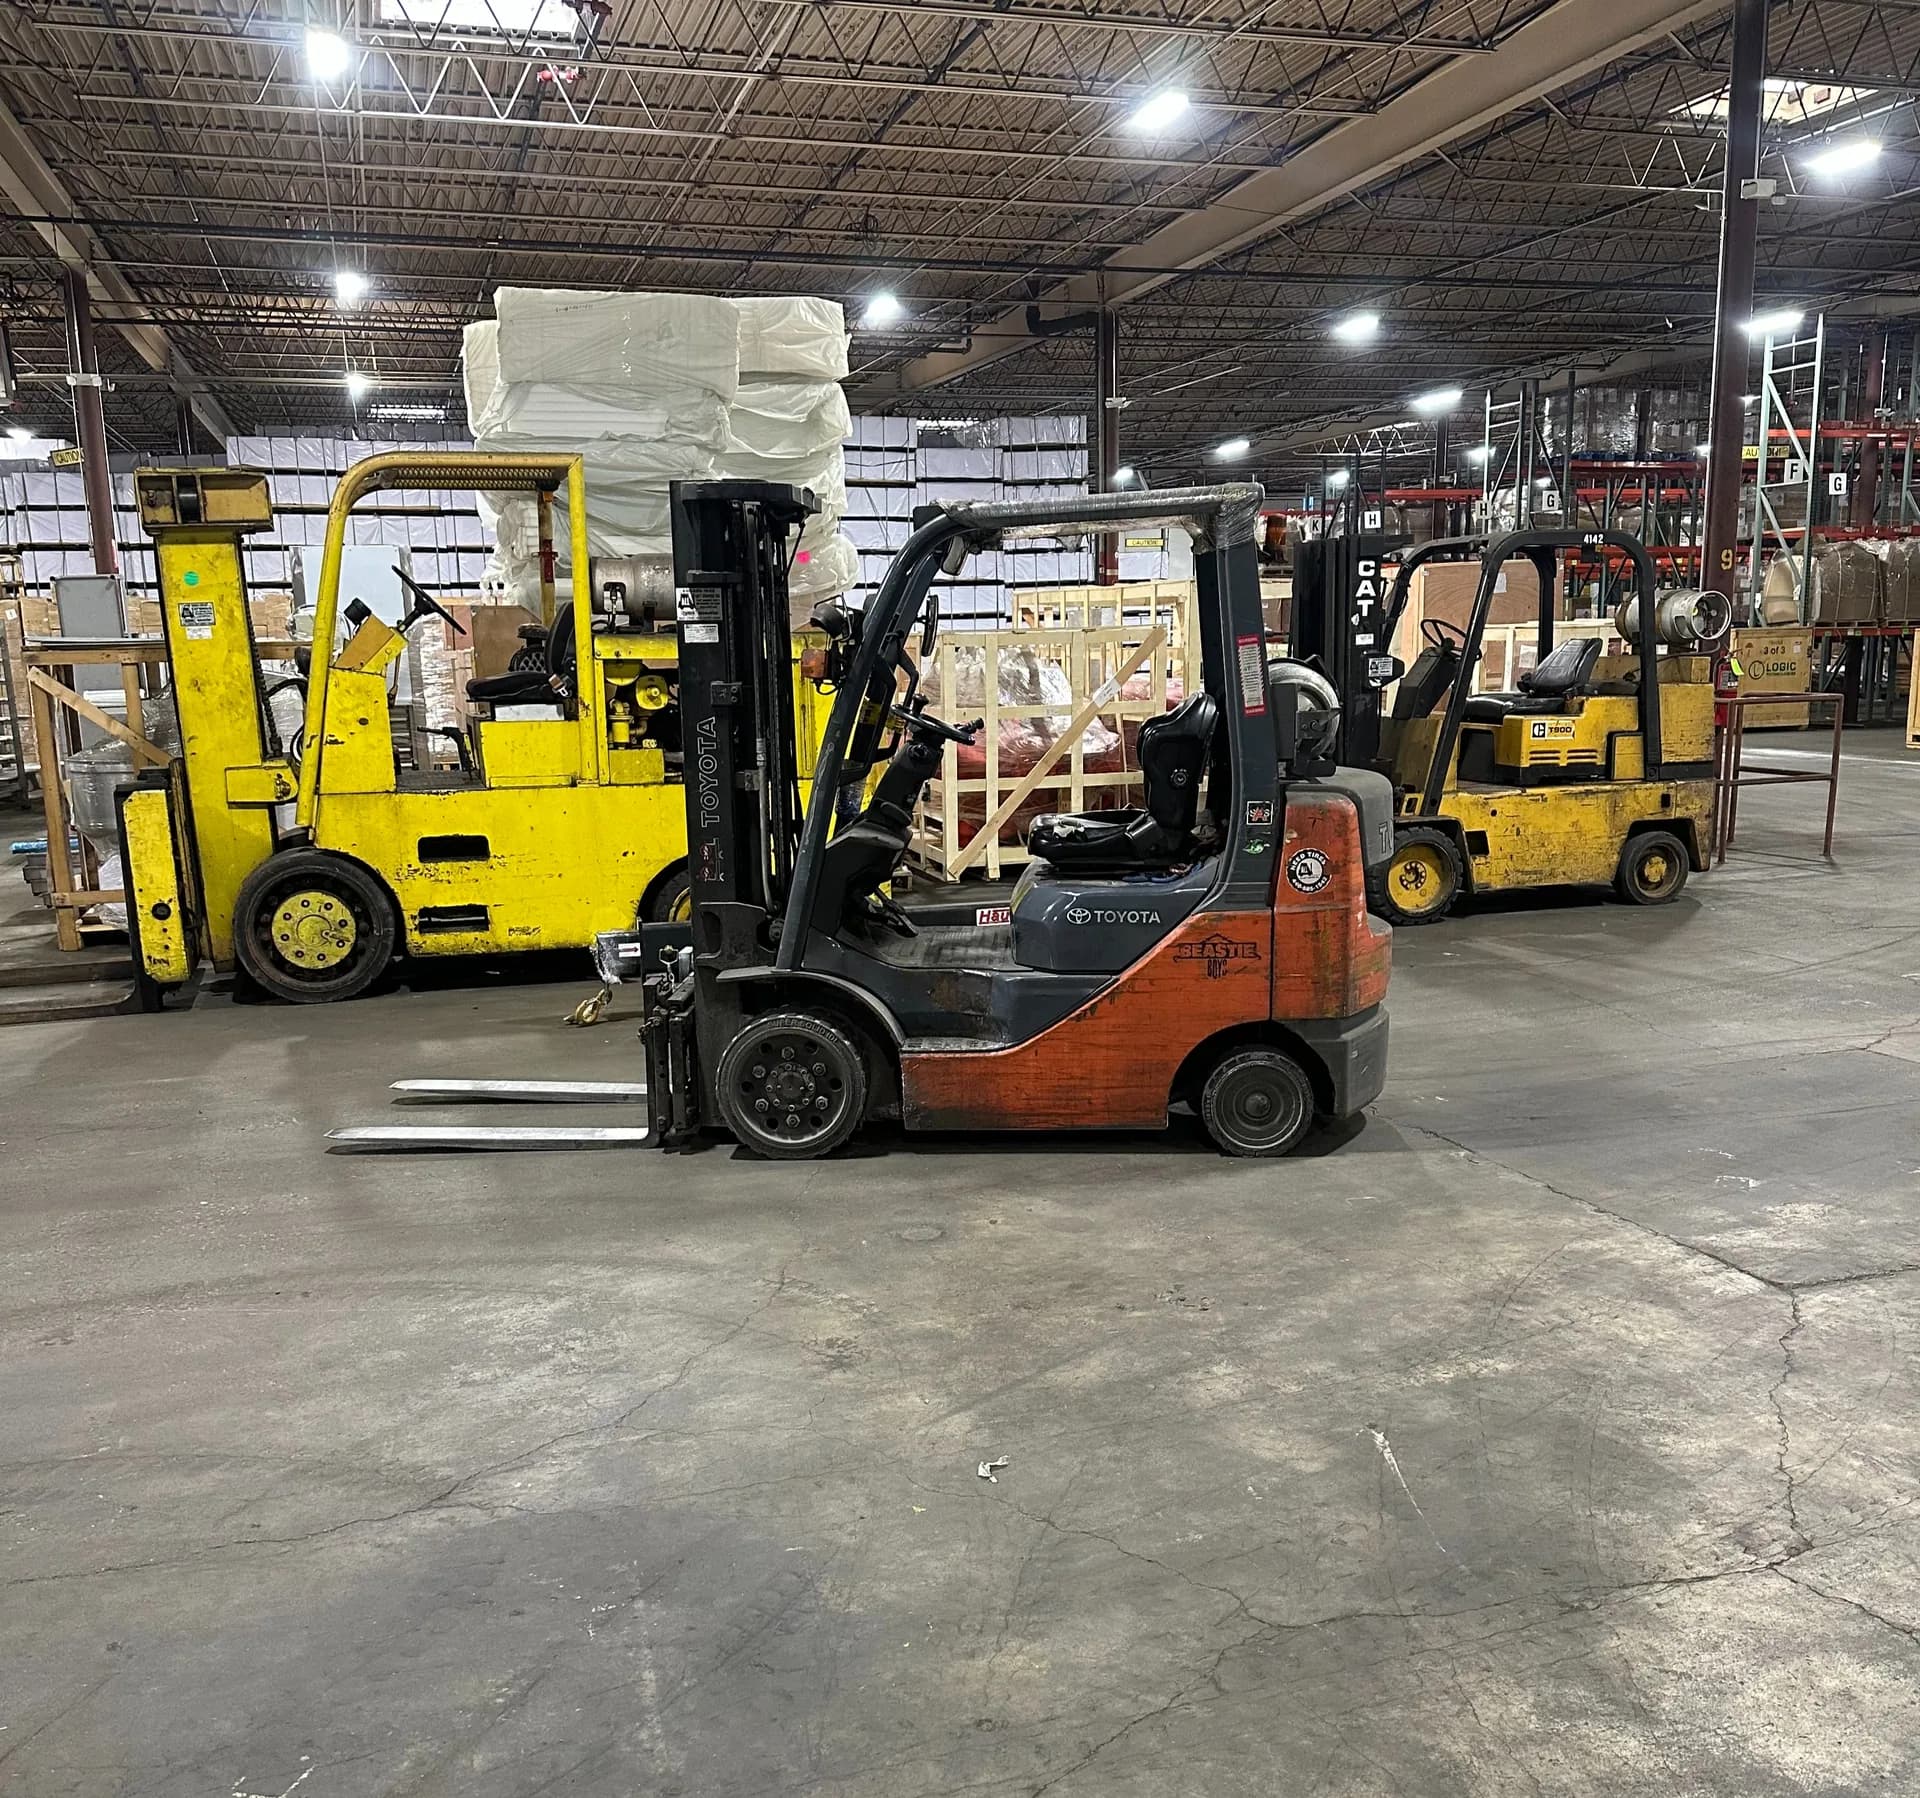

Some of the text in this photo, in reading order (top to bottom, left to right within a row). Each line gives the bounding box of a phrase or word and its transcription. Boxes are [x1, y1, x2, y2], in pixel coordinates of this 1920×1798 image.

[1789, 463, 1799, 480] F
[1834, 476, 1843, 492] G
[1479, 502, 1488, 516] H
[1546, 494, 1555, 508] G
[1311, 519, 1320, 533] K
[1368, 513, 1378, 529] H
[1583, 534, 1604, 544] 4142
[1720, 548, 1733, 570] 9
[1355, 560, 1377, 617] CAT
[1763, 645, 1786, 655] 3 of 3
[1766, 661, 1797, 672] LOGIC
[696, 716, 720, 828] TOYOTA
[1290, 853, 1306, 871] NEED
[1094, 910, 1160, 924] TOYOTA
[1179, 942, 1258, 959] BEASTIE
